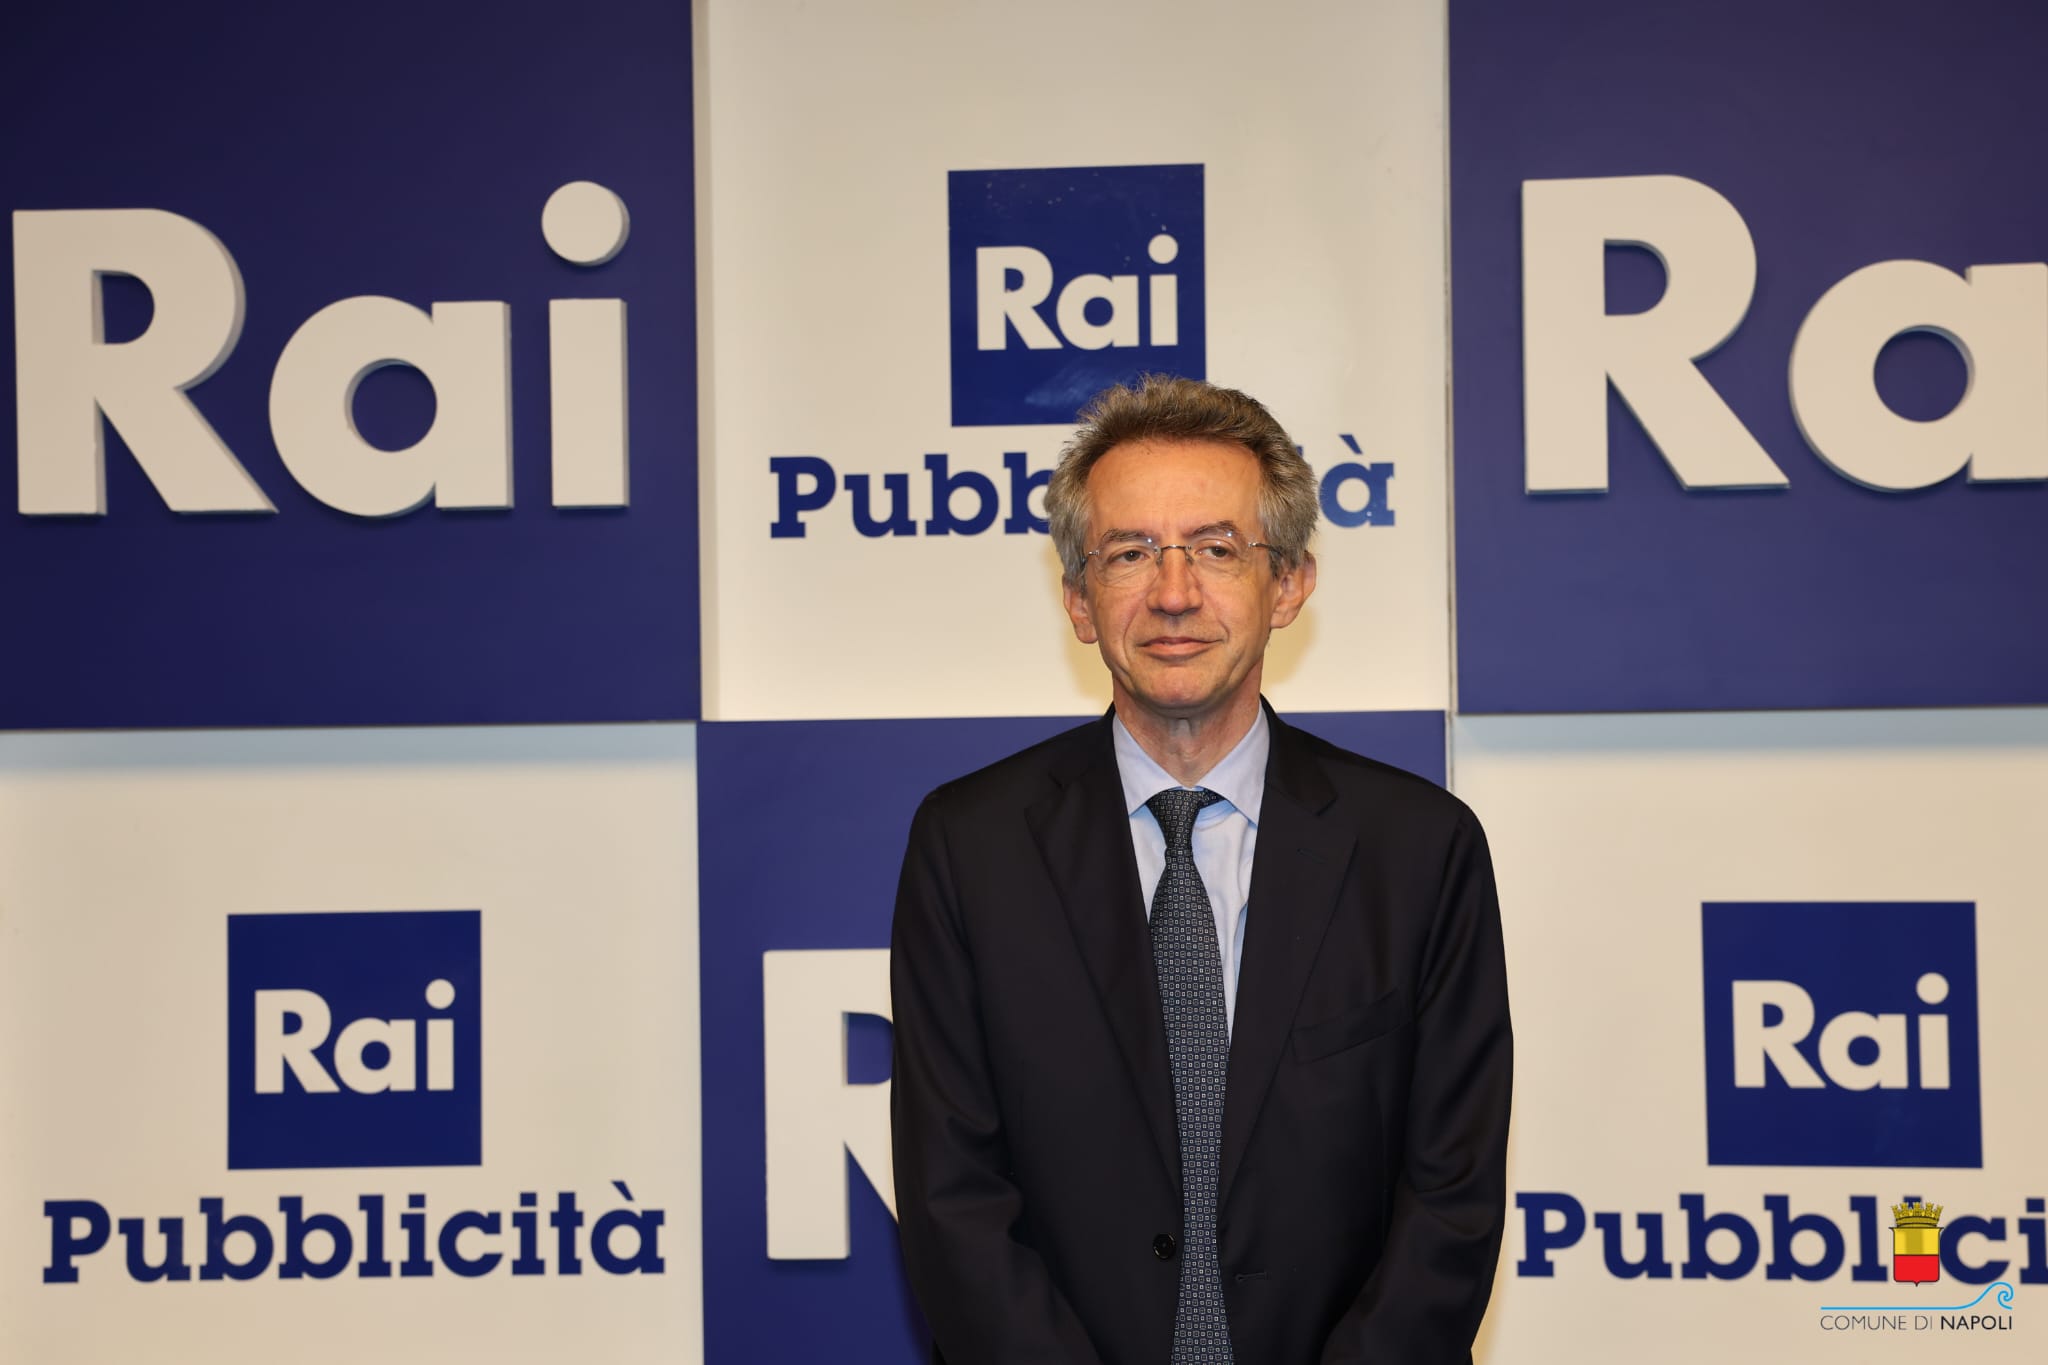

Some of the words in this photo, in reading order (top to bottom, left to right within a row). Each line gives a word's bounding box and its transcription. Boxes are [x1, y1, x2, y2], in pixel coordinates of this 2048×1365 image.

[12, 181, 631, 517] Rai
[976, 234, 1178, 351] Rai
[1521, 174, 2048, 495] Ra
[769, 433, 1396, 540] Pubbà
[255, 979, 455, 1094] Rai
[1732, 973, 1950, 1091] Rai
[43, 1180, 666, 1284] Pubblicità
[1515, 1192, 2048, 1286] Pubblci
